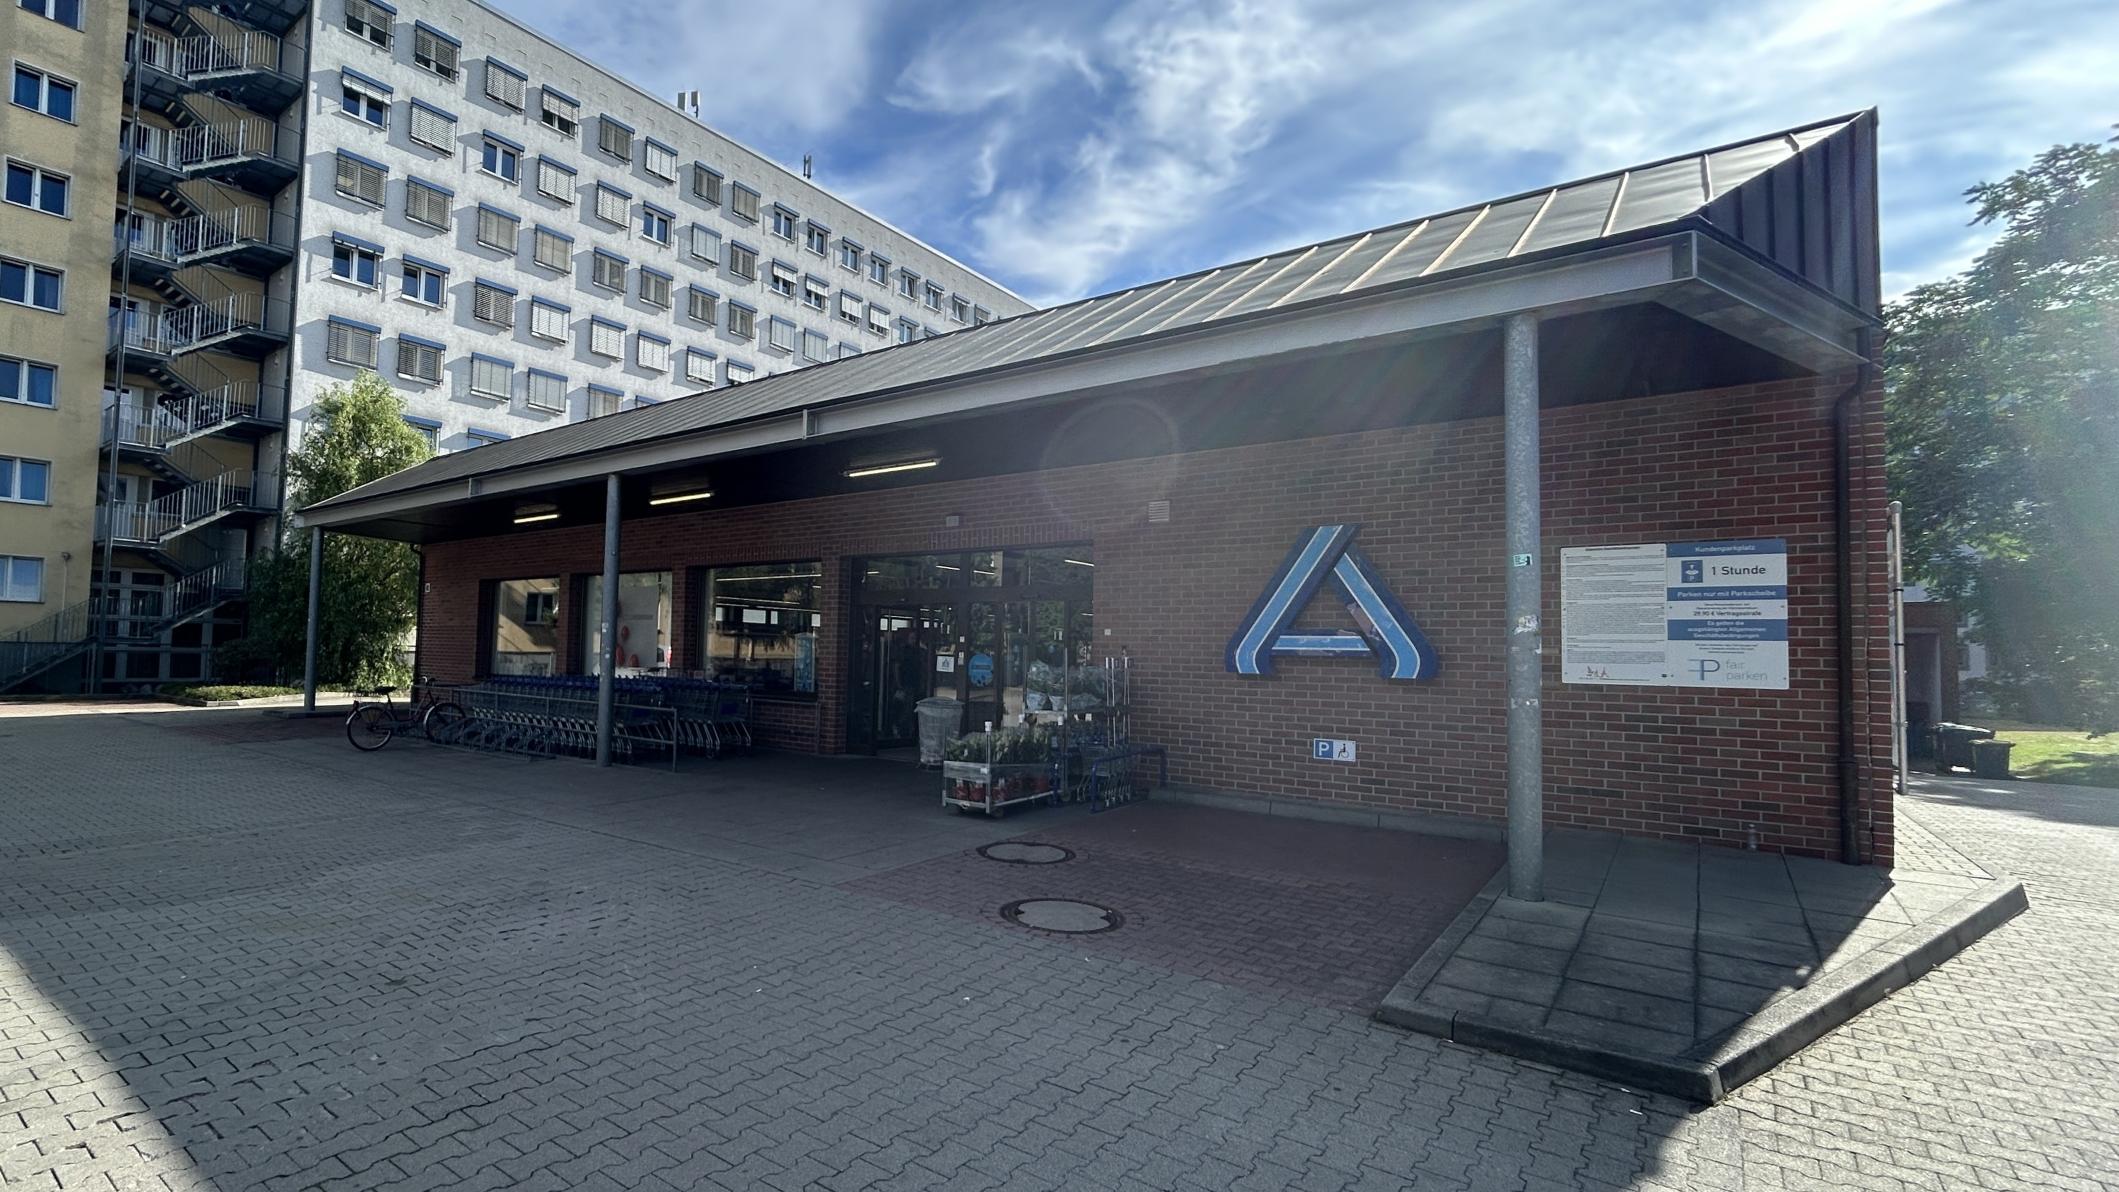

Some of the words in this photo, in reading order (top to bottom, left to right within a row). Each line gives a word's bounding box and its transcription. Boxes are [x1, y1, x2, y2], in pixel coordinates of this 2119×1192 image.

[1695, 544, 1756, 553] Kundenparkplatz
[1712, 566, 1717, 576] 1
[1721, 565, 1767, 576] Stunde
[1731, 589, 1776, 597] Parkscheibe
[1726, 659, 1746, 670] fair
[1726, 671, 1768, 681] parken
[1318, 741, 1330, 757] P
